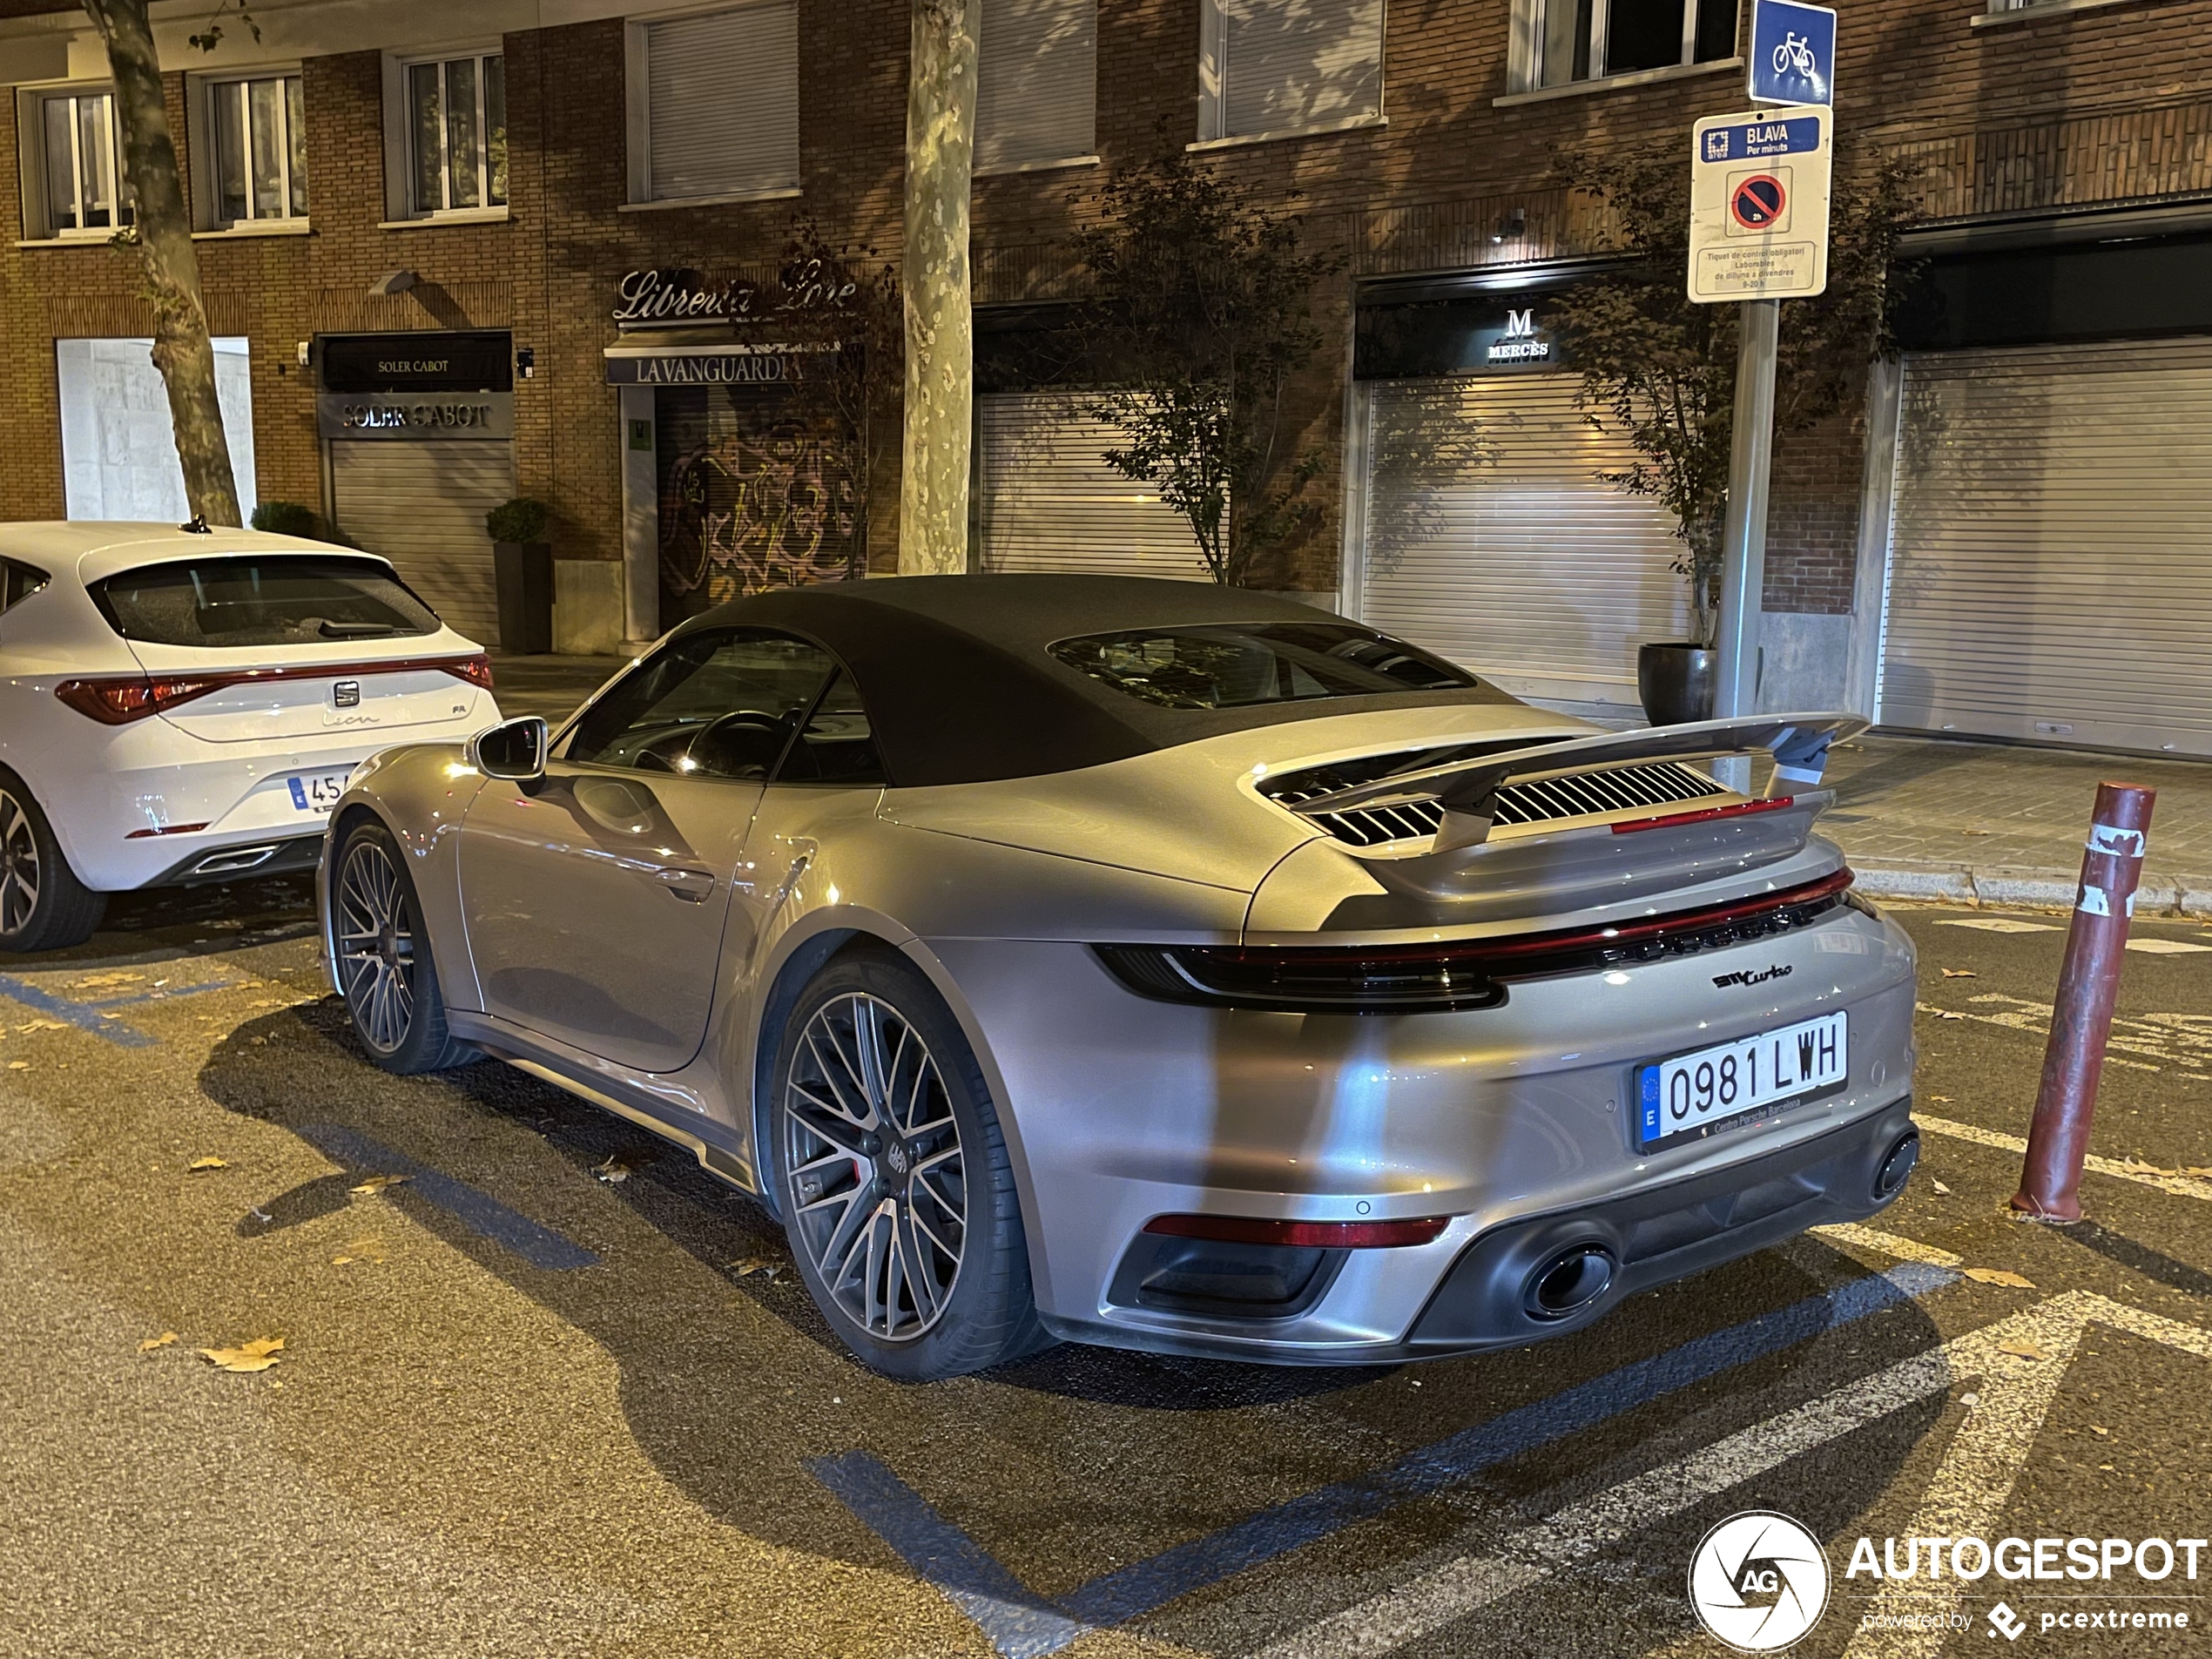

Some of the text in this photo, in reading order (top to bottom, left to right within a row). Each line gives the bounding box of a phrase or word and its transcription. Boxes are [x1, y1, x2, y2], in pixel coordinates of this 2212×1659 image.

[1746, 124, 1789, 145] BLAVA
[1746, 143, 1788, 155] Per minuts
[1752, 212, 1763, 221] 2h
[1707, 246, 1805, 261] Tiquet de control obligatori
[1735, 260, 1775, 269] Laborables
[1715, 272, 1724, 280] de
[1725, 271, 1750, 280] dilluns
[1758, 268, 1795, 278] divendres
[1743, 279, 1765, 288] 9-20 h
[1505, 308, 1534, 337] M
[1488, 341, 1548, 359] MERCÈS
[378, 360, 448, 373] SOLER CABOT
[343, 402, 492, 428] SOLER CABOT
[452, 705, 466, 714] FR
[322, 711, 381, 727] Leon
[313, 774, 349, 802] 45
[1743, 964, 1792, 987] turbo
[1670, 1024, 1836, 1120] 0981 LWH
[1646, 1109, 1656, 1126] E
[1714, 1098, 1801, 1134] Centro Porsche Barcelona
